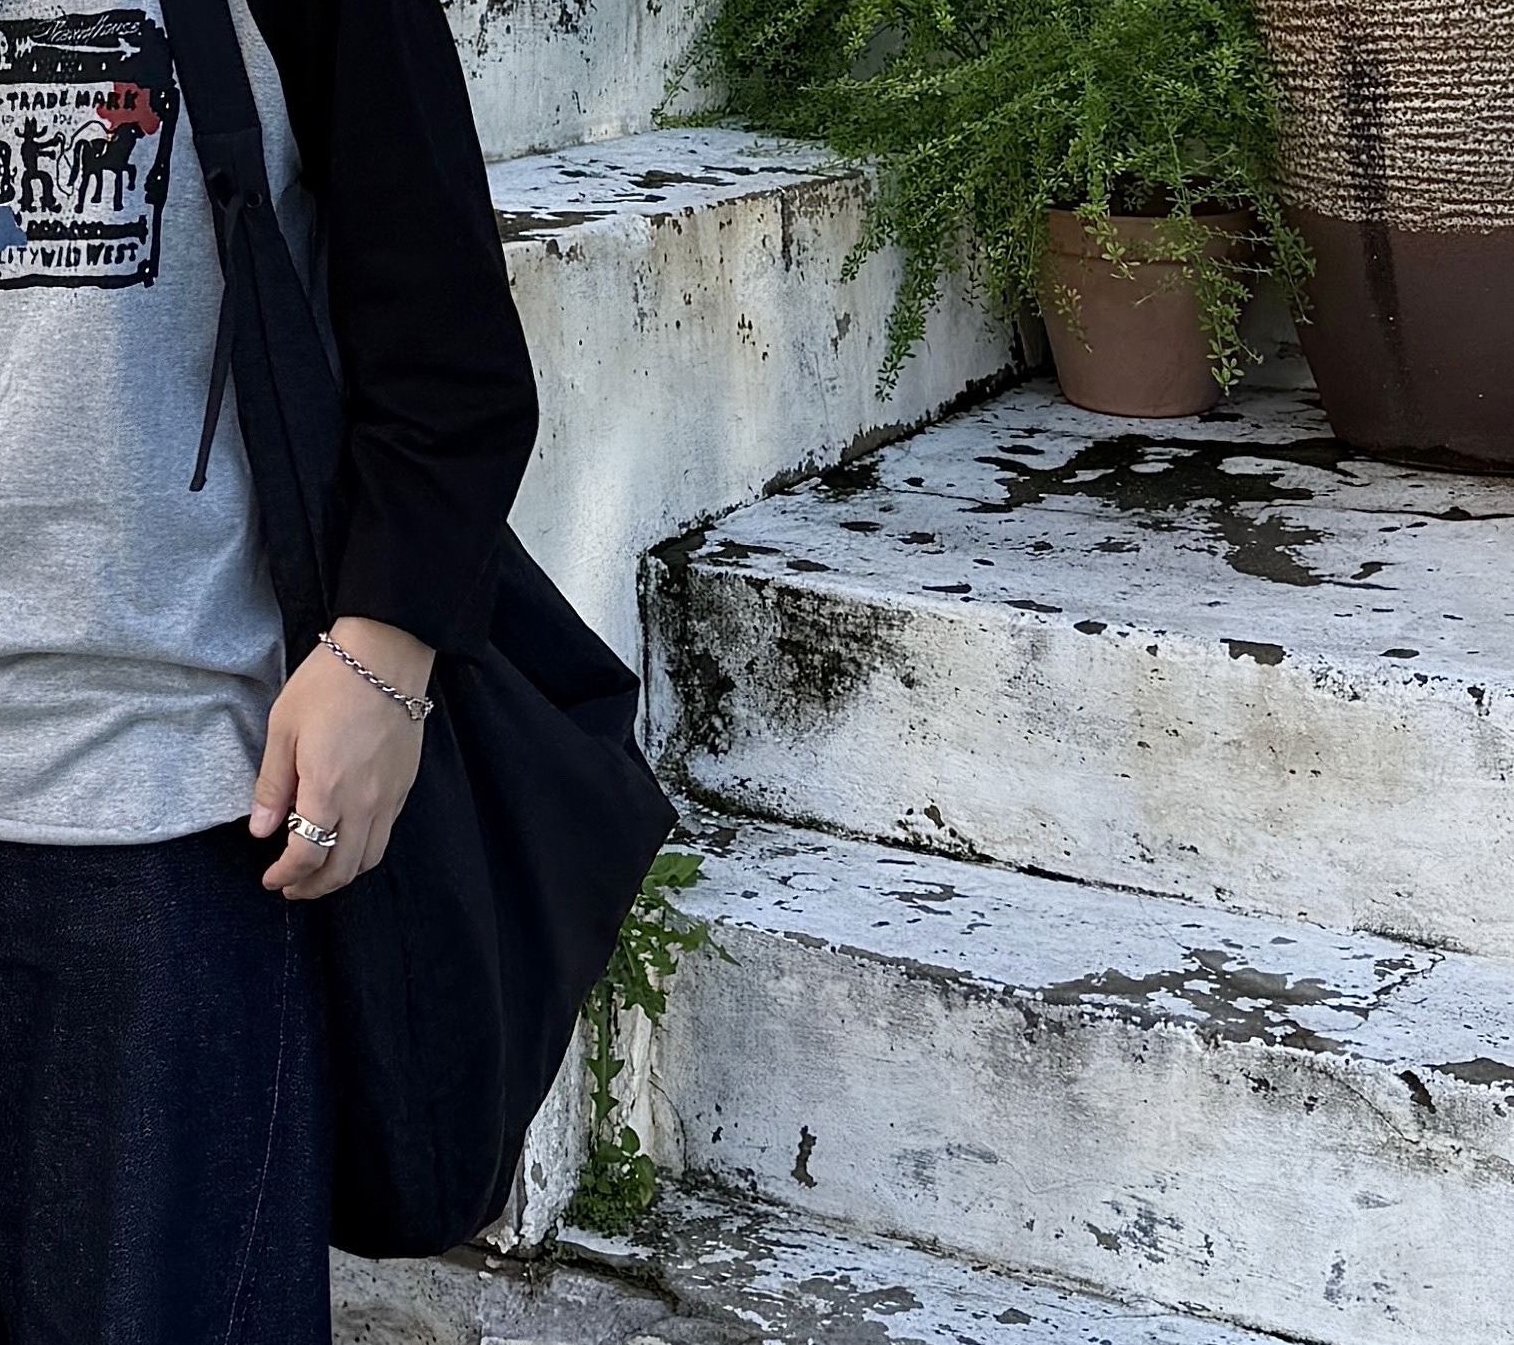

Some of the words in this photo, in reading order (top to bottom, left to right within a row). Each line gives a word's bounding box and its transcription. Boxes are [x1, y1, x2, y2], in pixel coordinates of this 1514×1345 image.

[7, 88, 69, 111] TRADE
[75, 84, 139, 111] MARK
[87, 242, 139, 266] WEST
